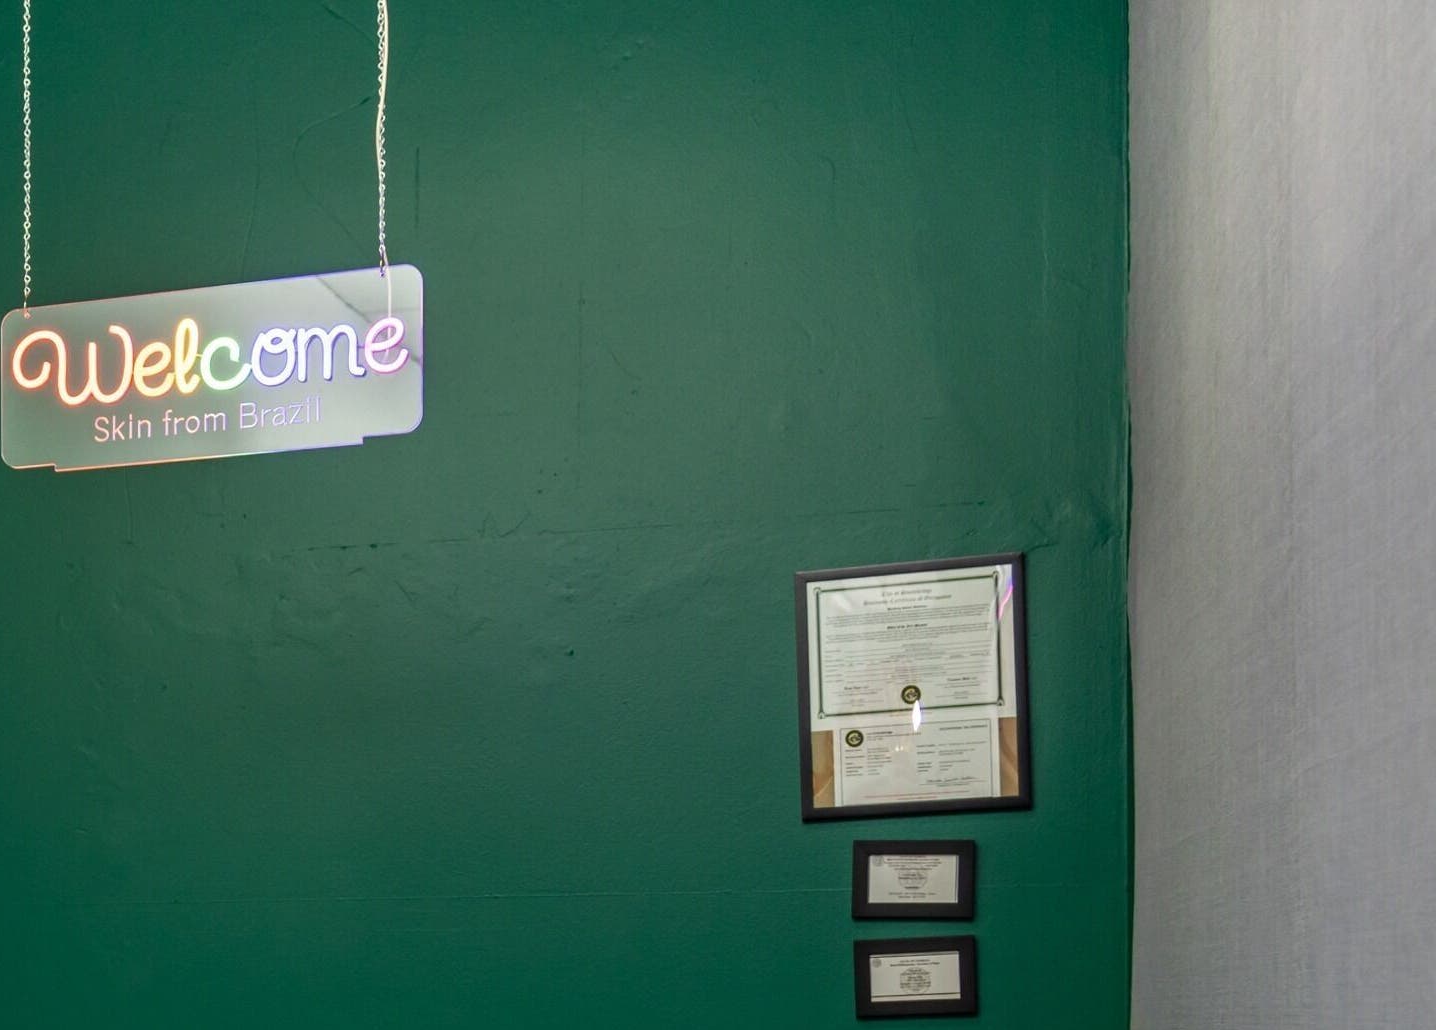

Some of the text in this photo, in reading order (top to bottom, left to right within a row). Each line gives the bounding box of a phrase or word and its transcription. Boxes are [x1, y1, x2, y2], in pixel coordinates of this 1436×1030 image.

[12, 316, 411, 406] Welcome
[93, 395, 322, 443] Skin from Brazil
